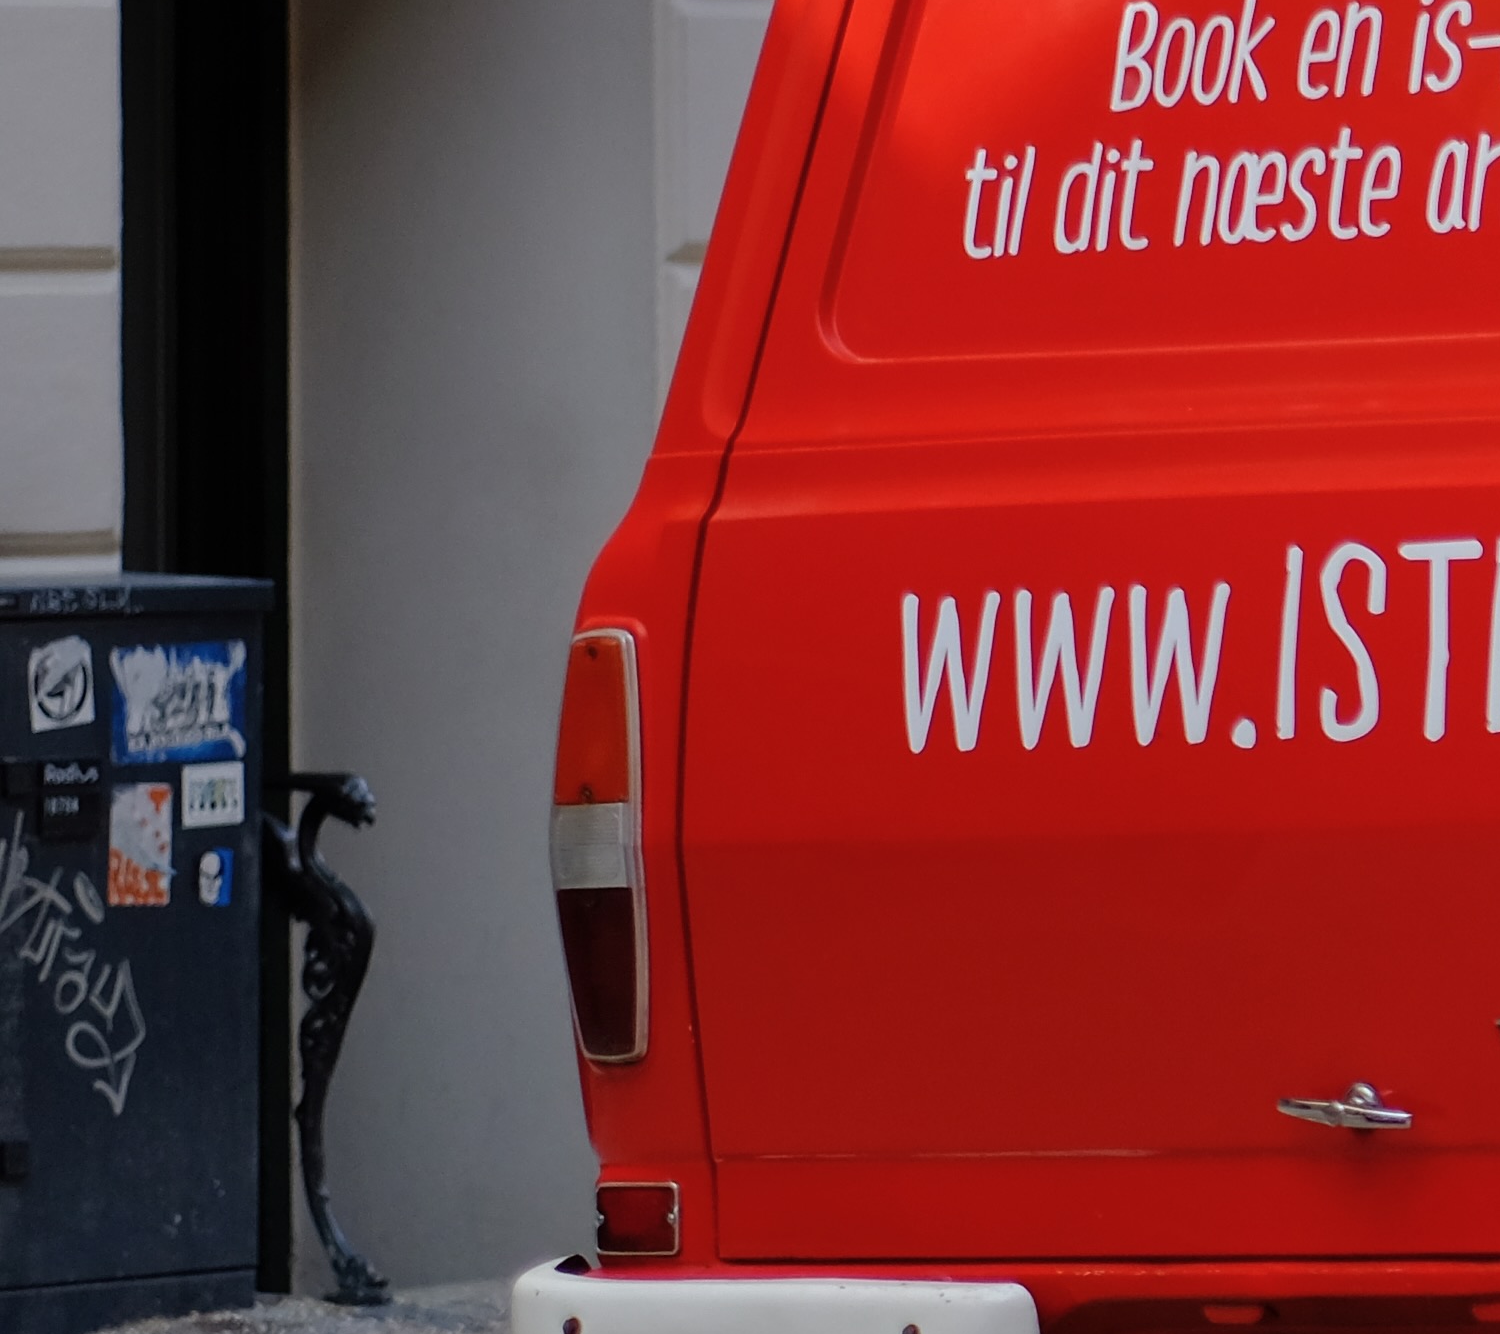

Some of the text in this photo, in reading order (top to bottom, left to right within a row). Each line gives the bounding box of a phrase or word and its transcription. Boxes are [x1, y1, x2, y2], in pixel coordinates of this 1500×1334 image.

[1296, 0, 1384, 101] en
[962, 144, 1037, 261] til
[1052, 137, 1155, 255] dit
[1172, 126, 1403, 248] næste
